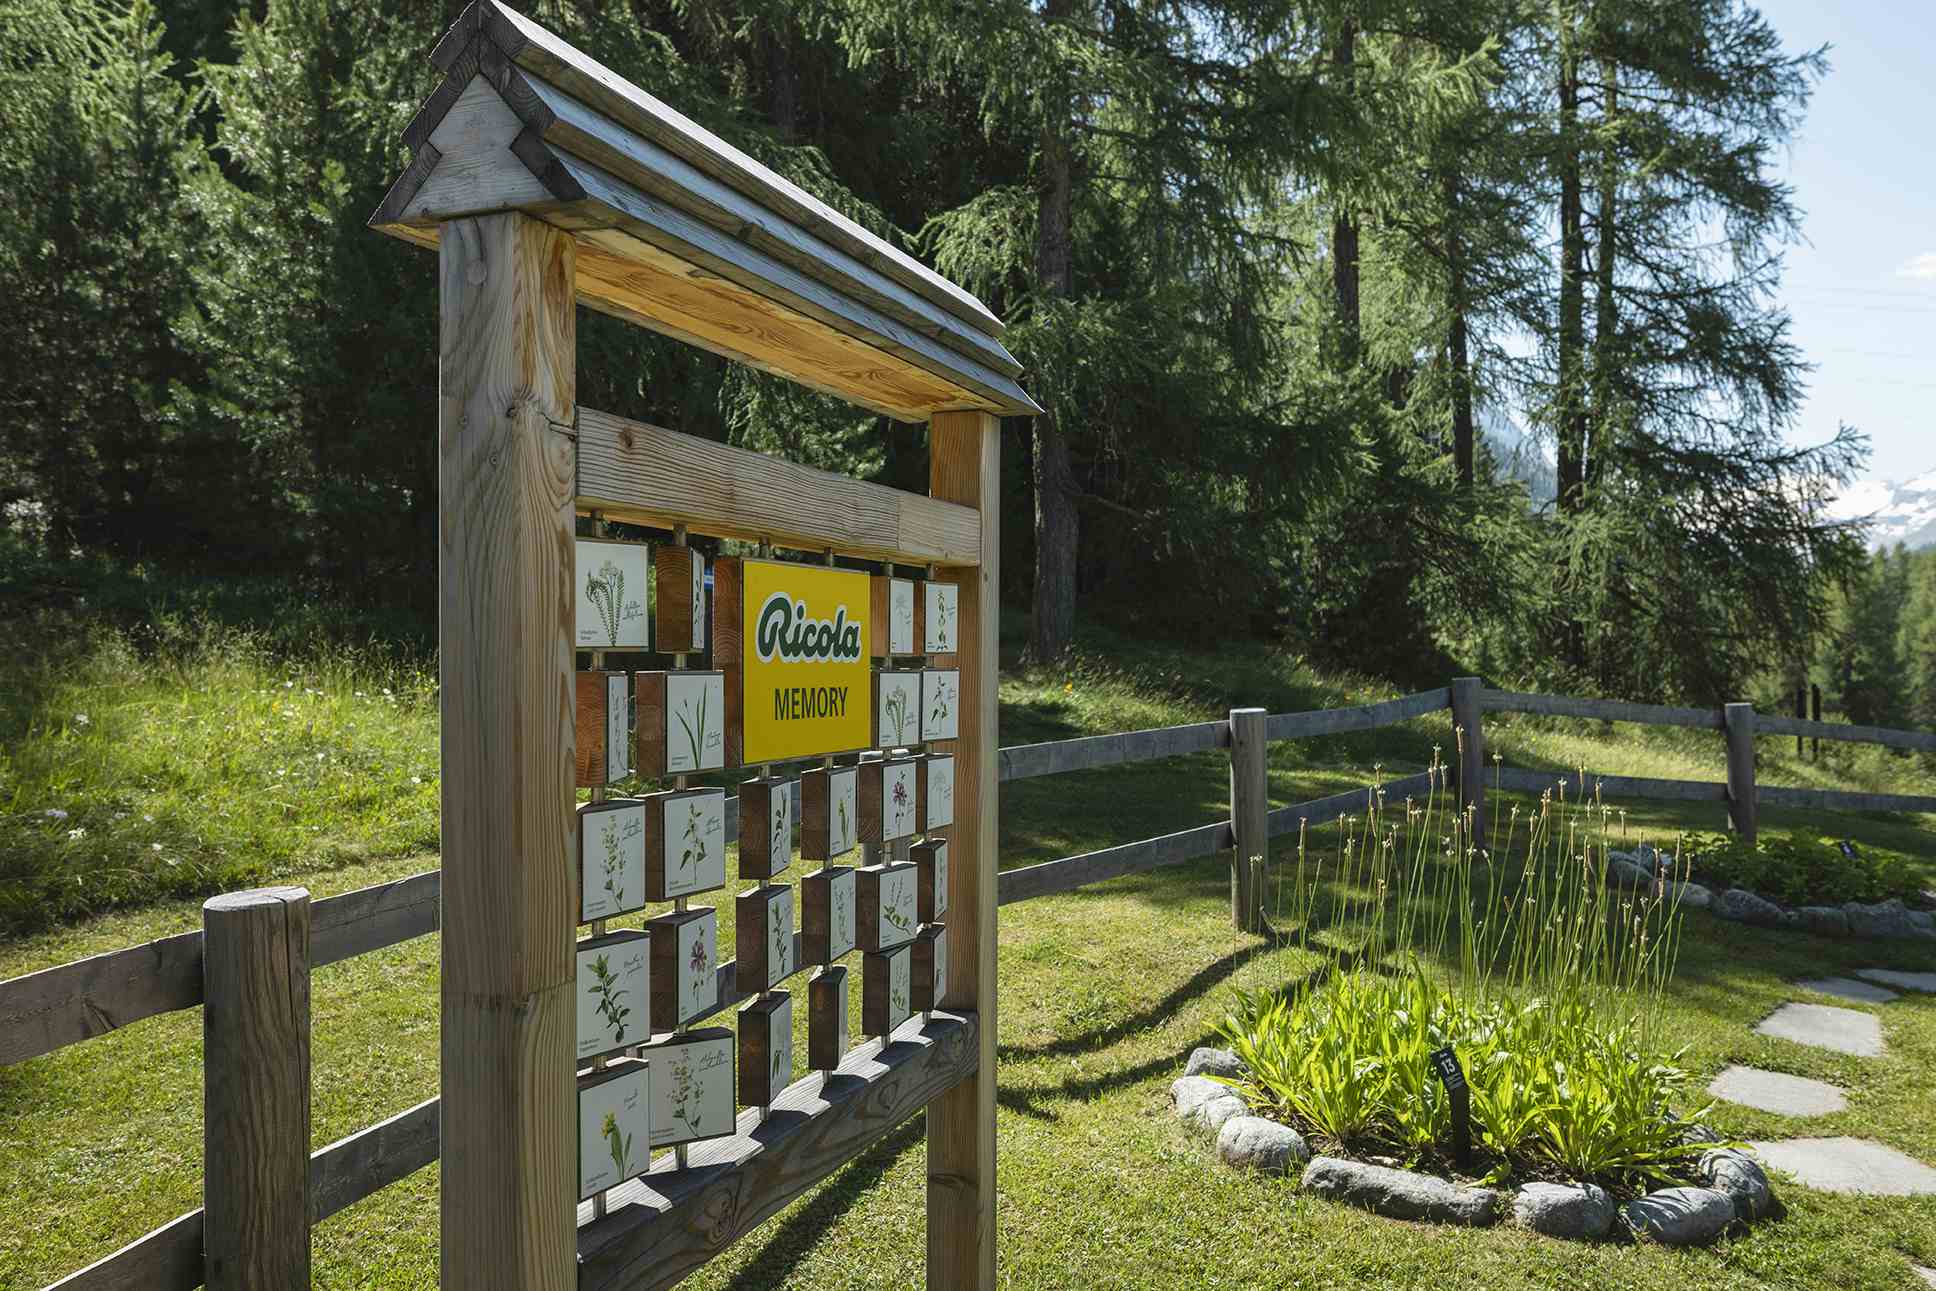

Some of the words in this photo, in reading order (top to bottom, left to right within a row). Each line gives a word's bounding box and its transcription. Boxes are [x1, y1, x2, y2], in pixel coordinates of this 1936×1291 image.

[757, 595, 861, 661] Ricola
[774, 686, 849, 721] MEMORY
[1441, 1058, 1455, 1074] 13
